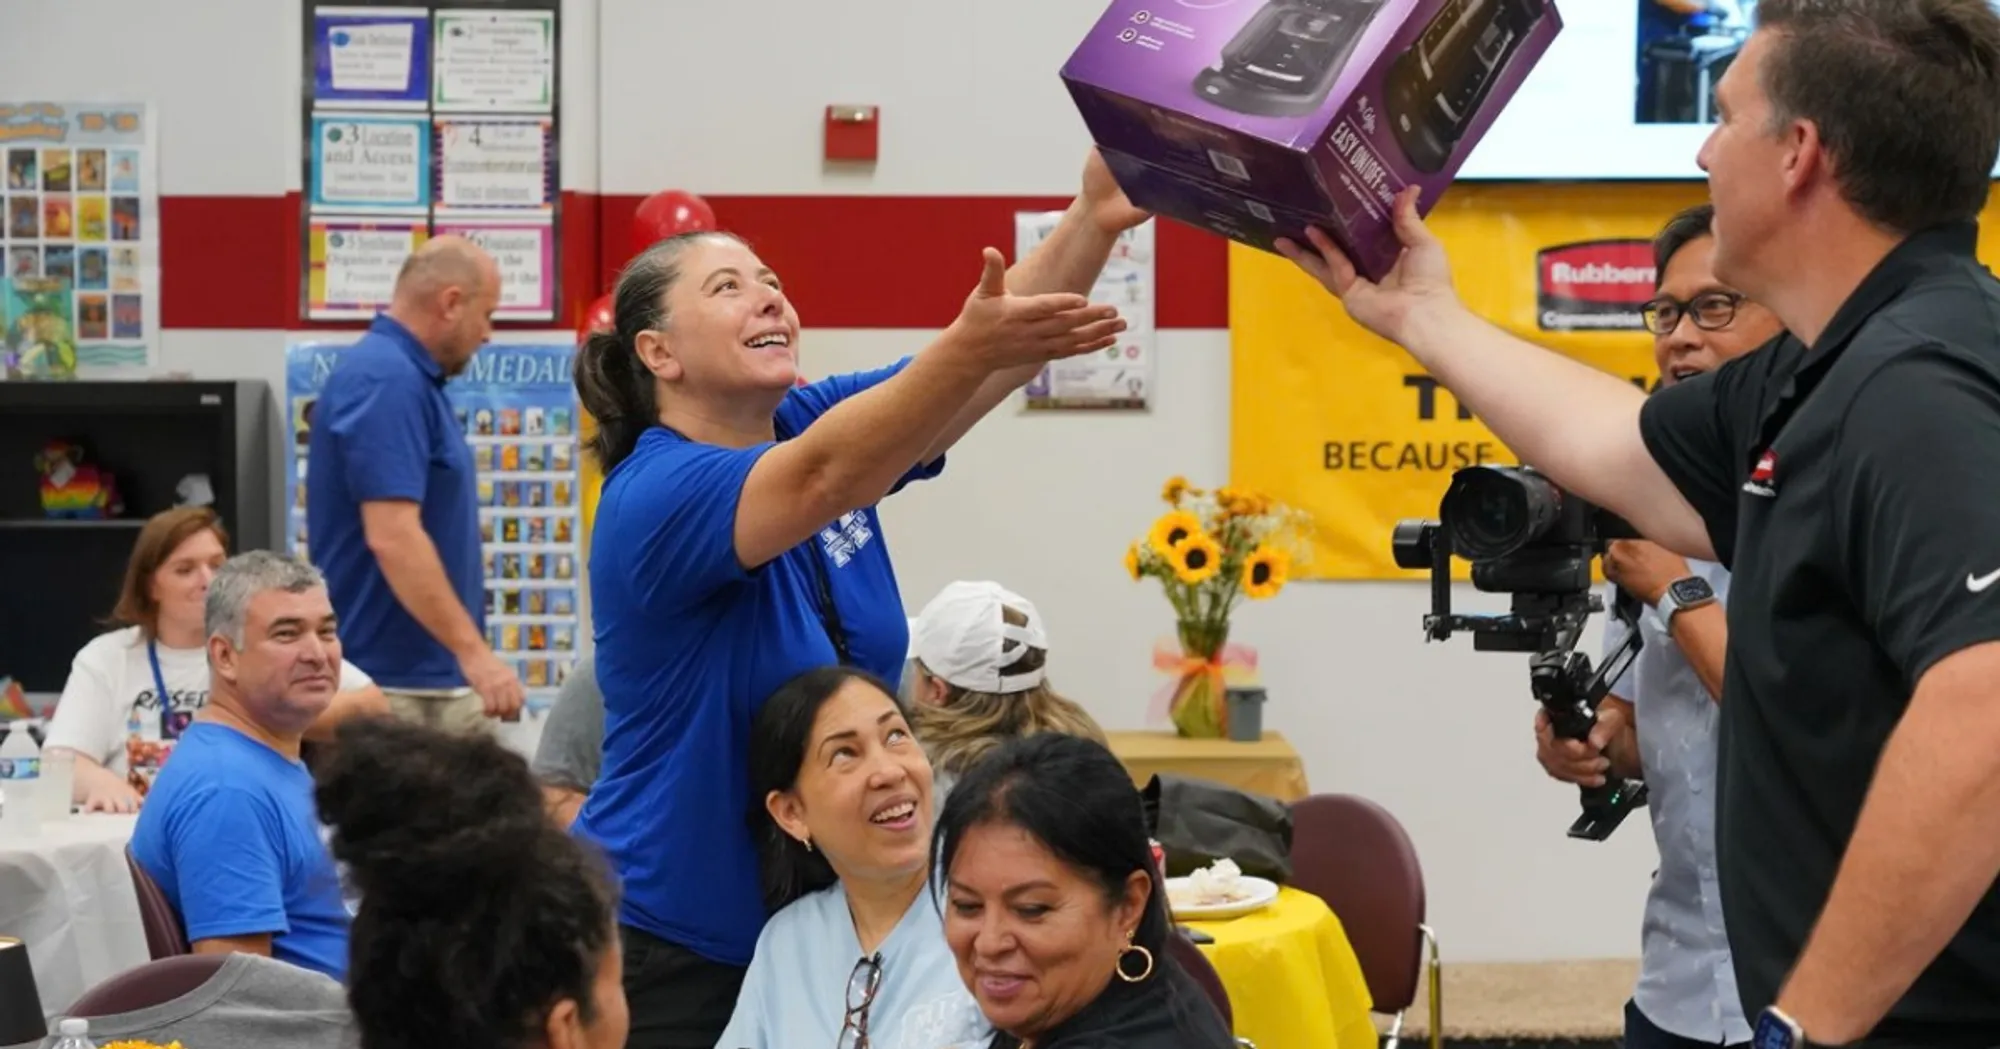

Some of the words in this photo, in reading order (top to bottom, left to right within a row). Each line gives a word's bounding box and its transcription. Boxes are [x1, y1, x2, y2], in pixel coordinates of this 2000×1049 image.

[344, 124, 359, 146] 3
[468, 124, 483, 147] 4
[325, 147, 354, 164] and
[1331, 121, 1360, 157] EASY
[1350, 145, 1387, 189] ON/OFF
[1551, 262, 1657, 284] Rubber
[467, 353, 571, 384] MEDAL
[1324, 441, 1493, 471] BECAUSE
[132, 689, 210, 711] RASE
